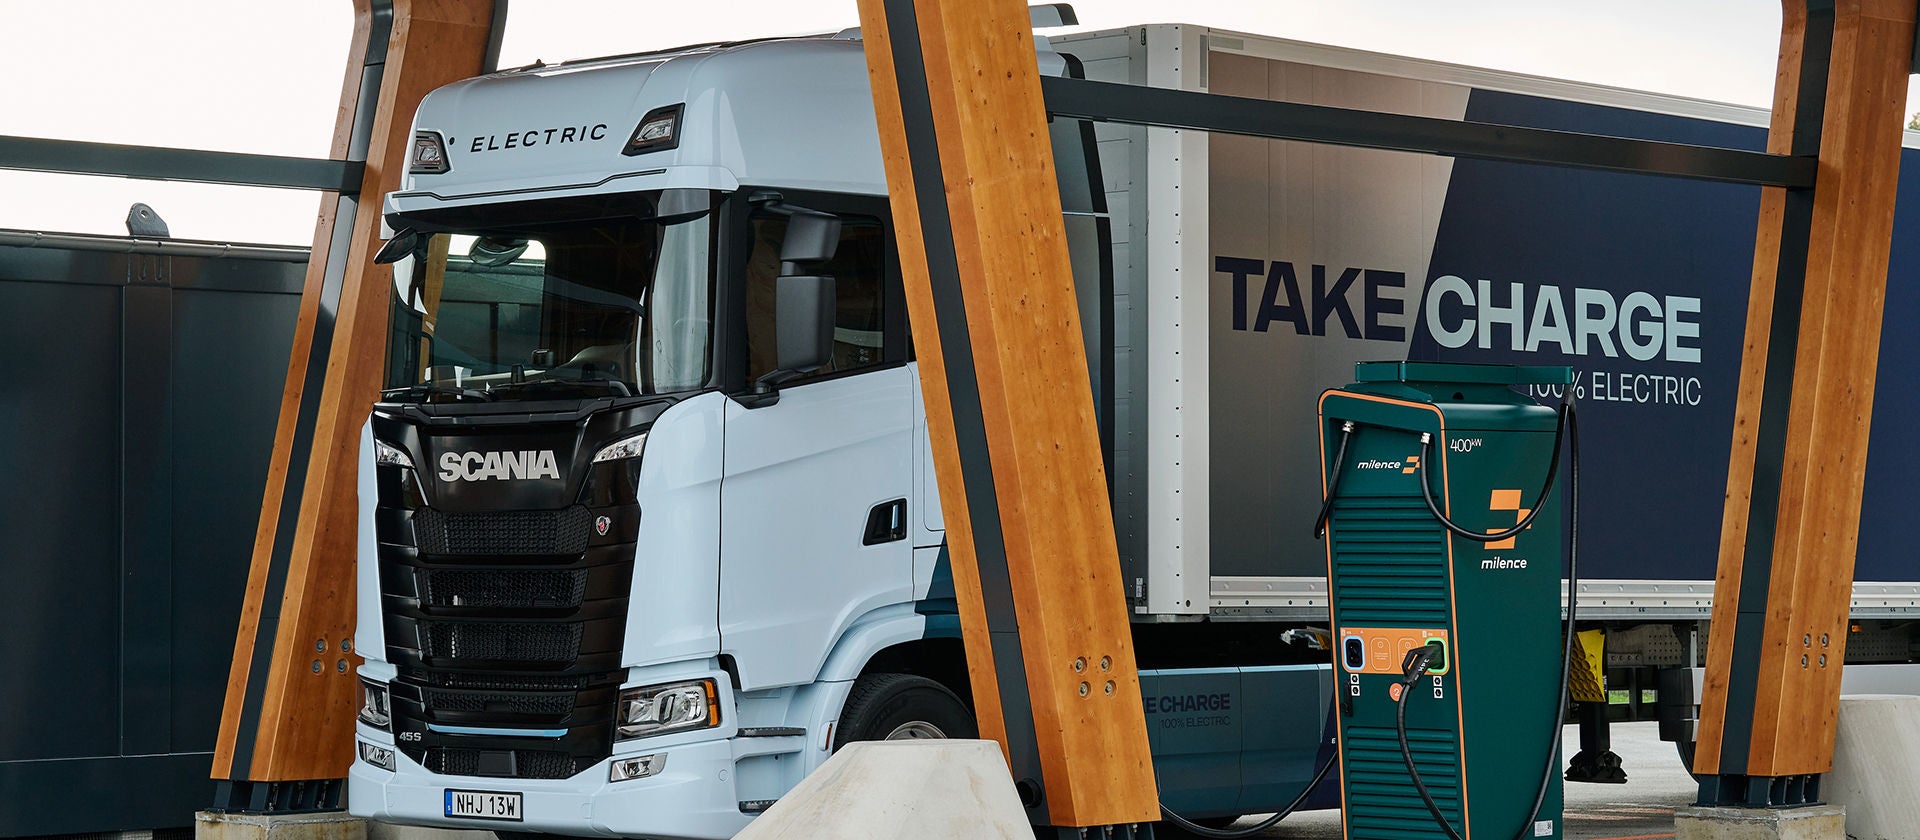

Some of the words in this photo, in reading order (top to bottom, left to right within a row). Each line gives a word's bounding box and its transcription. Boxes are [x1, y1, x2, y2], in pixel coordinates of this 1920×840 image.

[470, 123, 609, 153] ELECTRIC
[1215, 256, 1406, 343] TAKE
[1425, 275, 1701, 363] CHARGE
[1592, 371, 1702, 406] ELECTRIC
[438, 450, 560, 482] SCANIA
[1357, 459, 1401, 469] milence
[1481, 556, 1528, 569] milence
[1160, 693, 1231, 713] CHARGE
[1161, 718, 1185, 729] 100%
[1186, 715, 1231, 728] ELECTRIC
[457, 794, 484, 814] NHJ
[489, 796, 516, 816] 13W
